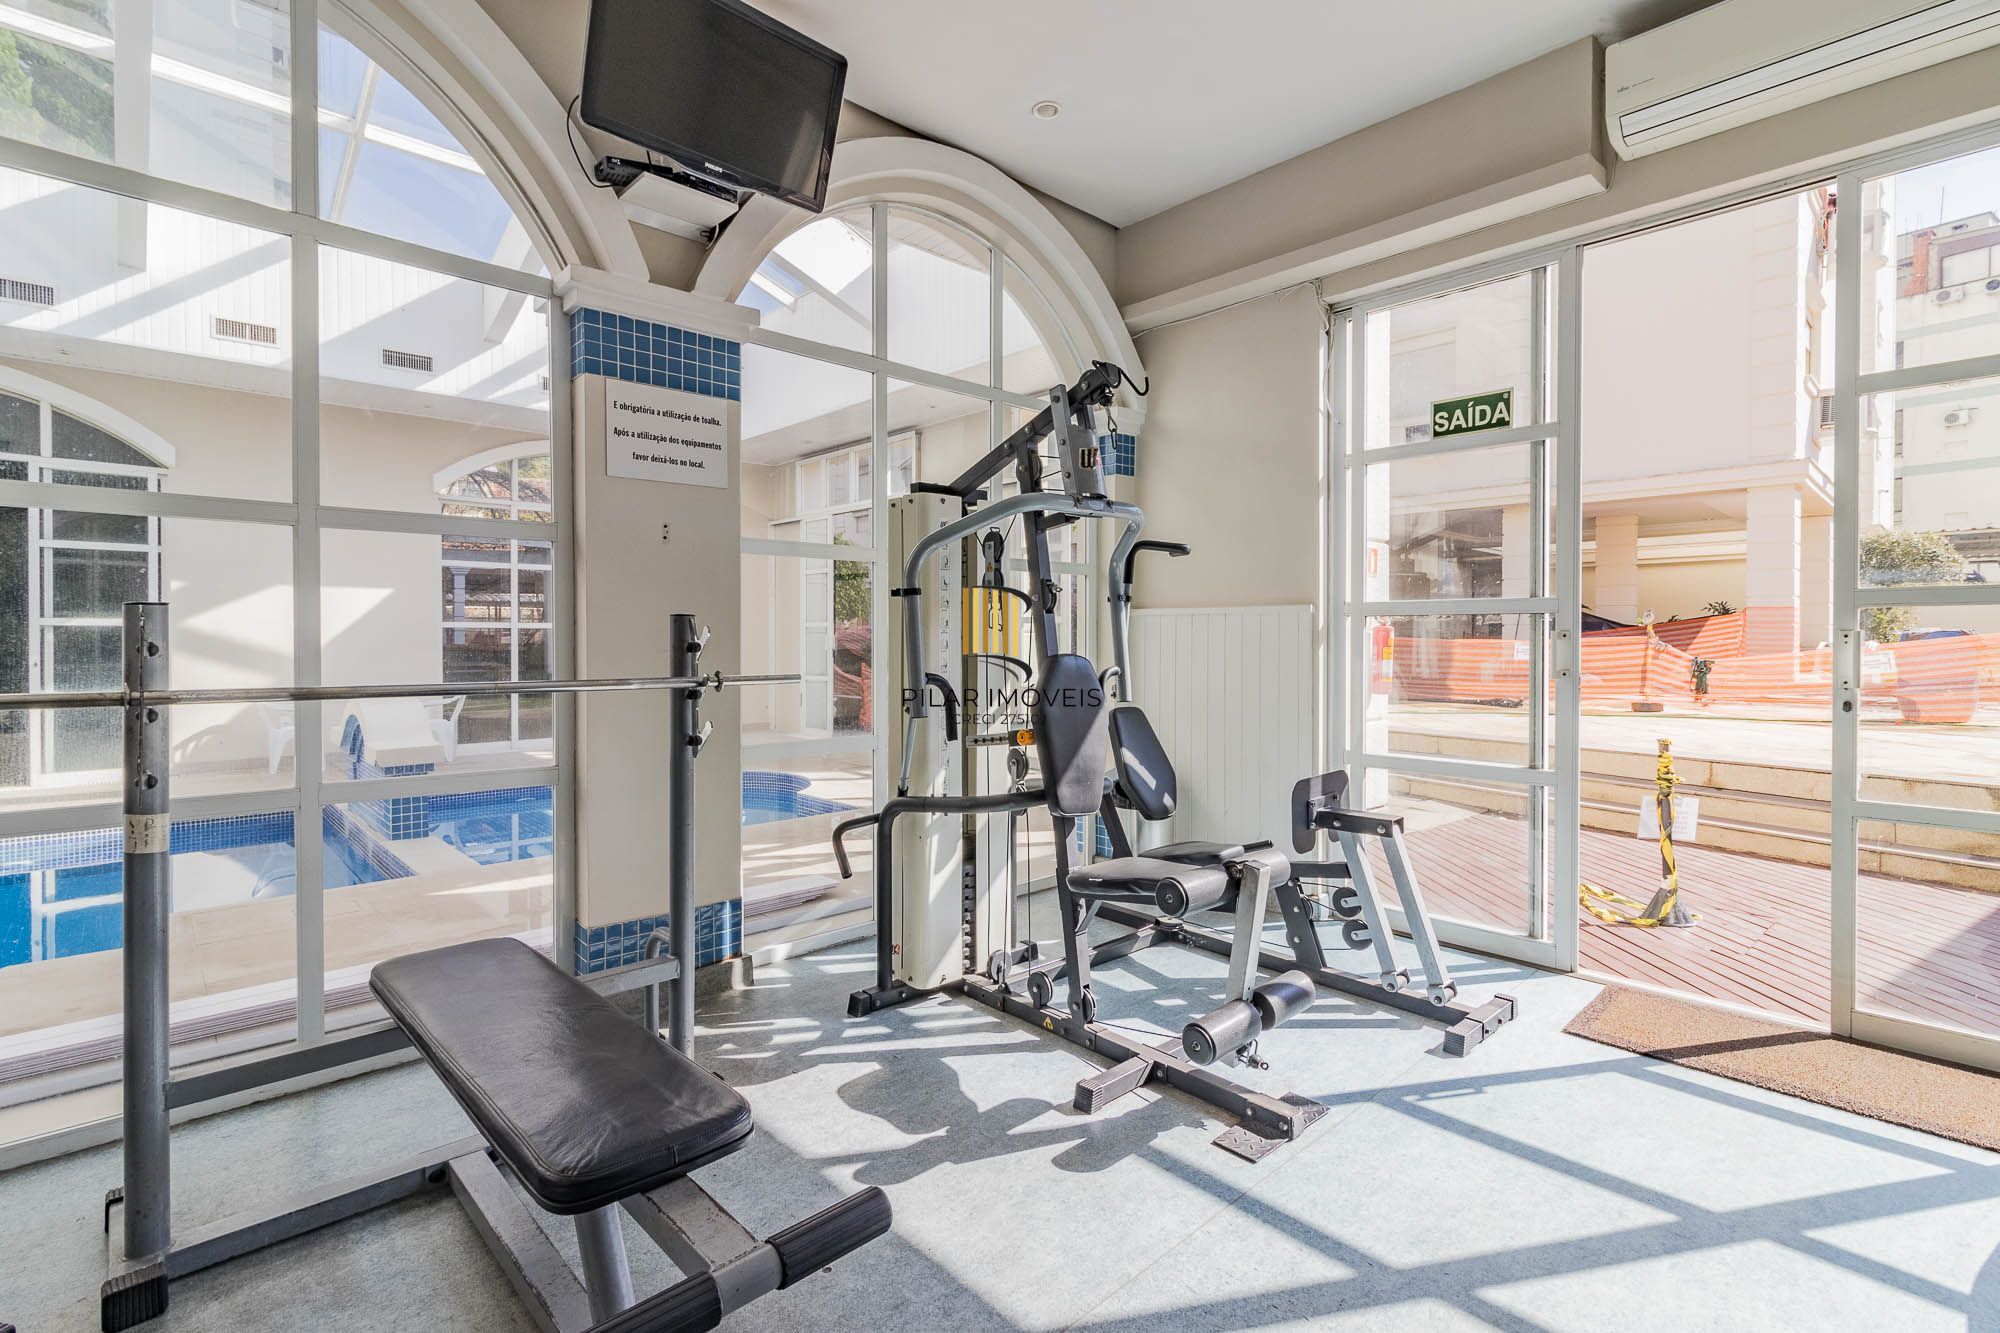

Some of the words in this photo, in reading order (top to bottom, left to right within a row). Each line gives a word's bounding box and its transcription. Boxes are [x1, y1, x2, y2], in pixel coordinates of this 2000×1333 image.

[619, 402, 655, 416] obrigatória
[662, 409, 692, 423] utilização
[693, 414, 700, 423] de
[701, 416, 722, 427] toalha.
[1434, 401, 1510, 433] SAÍDA
[613, 426, 630, 438] Após
[636, 430, 668, 444] utilização
[668, 435, 680, 445] dos
[681, 438, 722, 451] equipamentos
[632, 451, 649, 462] favor
[650, 453, 679, 466] deixá-los
[679, 459, 688, 467] no
[688, 459, 705, 469] local.
